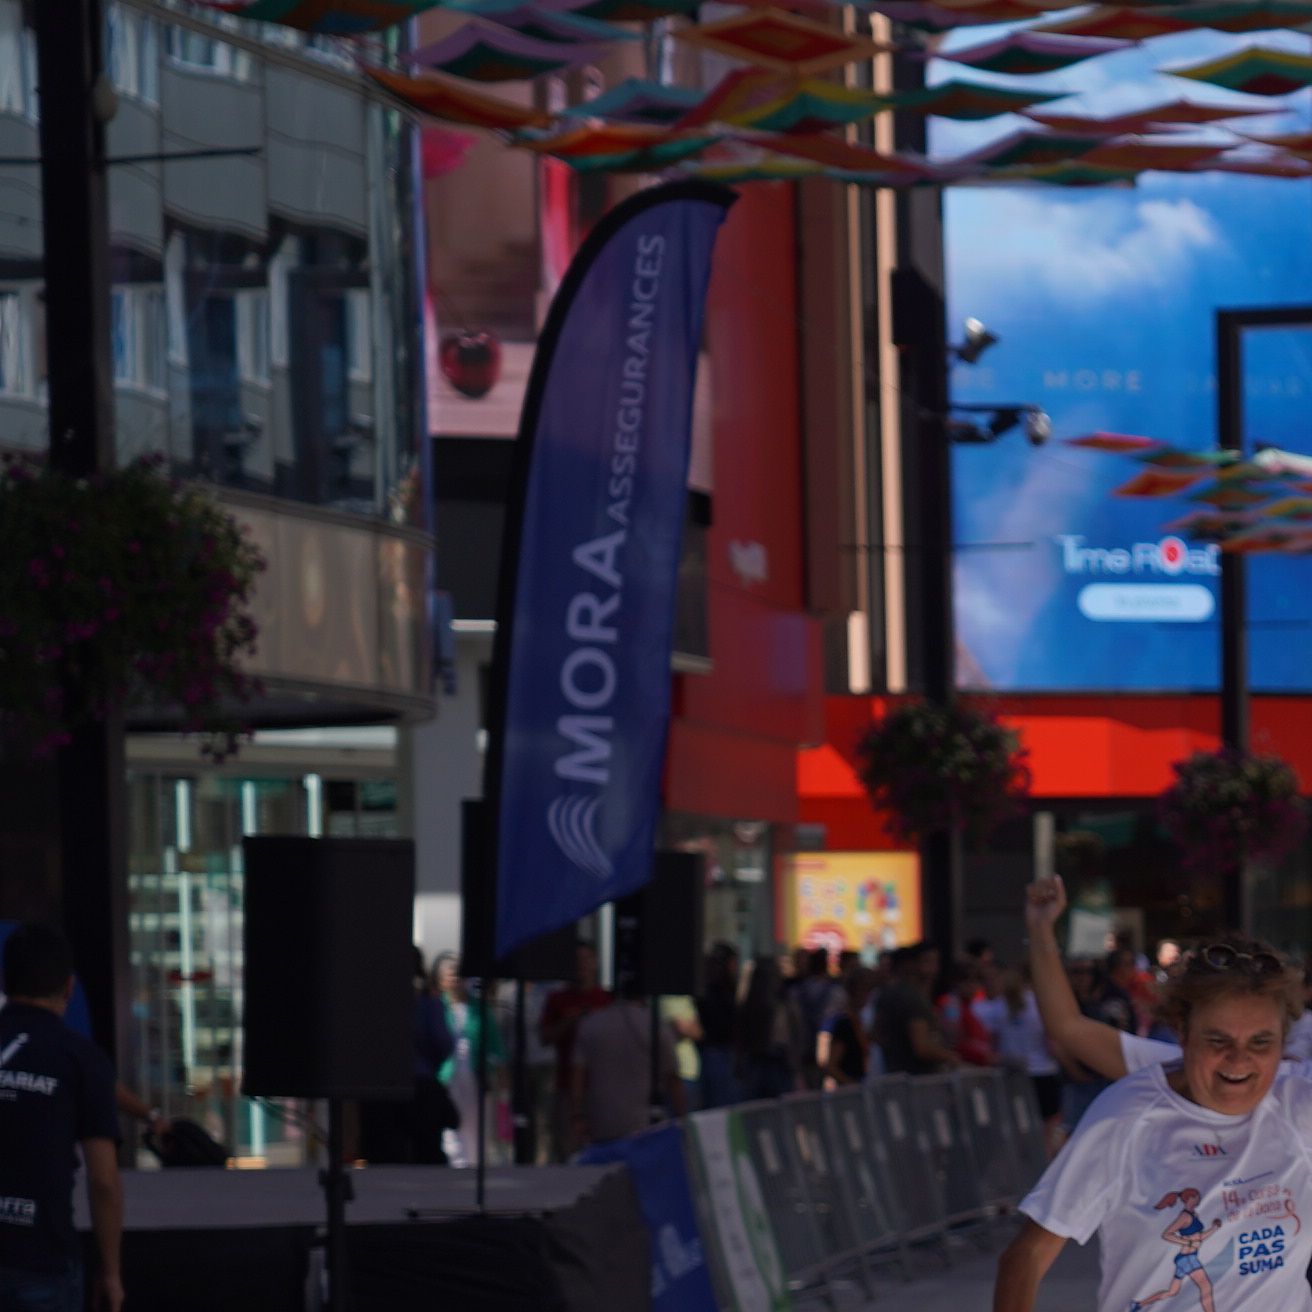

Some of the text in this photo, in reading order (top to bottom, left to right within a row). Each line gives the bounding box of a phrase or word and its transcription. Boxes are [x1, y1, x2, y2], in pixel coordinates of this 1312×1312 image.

[553, 233, 666, 785] MORA ASSEGURANCES
[0, 1069, 59, 1096] ARIAT
[1238, 1225, 1285, 1245] CADA
[1239, 1239, 1286, 1260] PAS
[1239, 1256, 1284, 1276] SUMA
